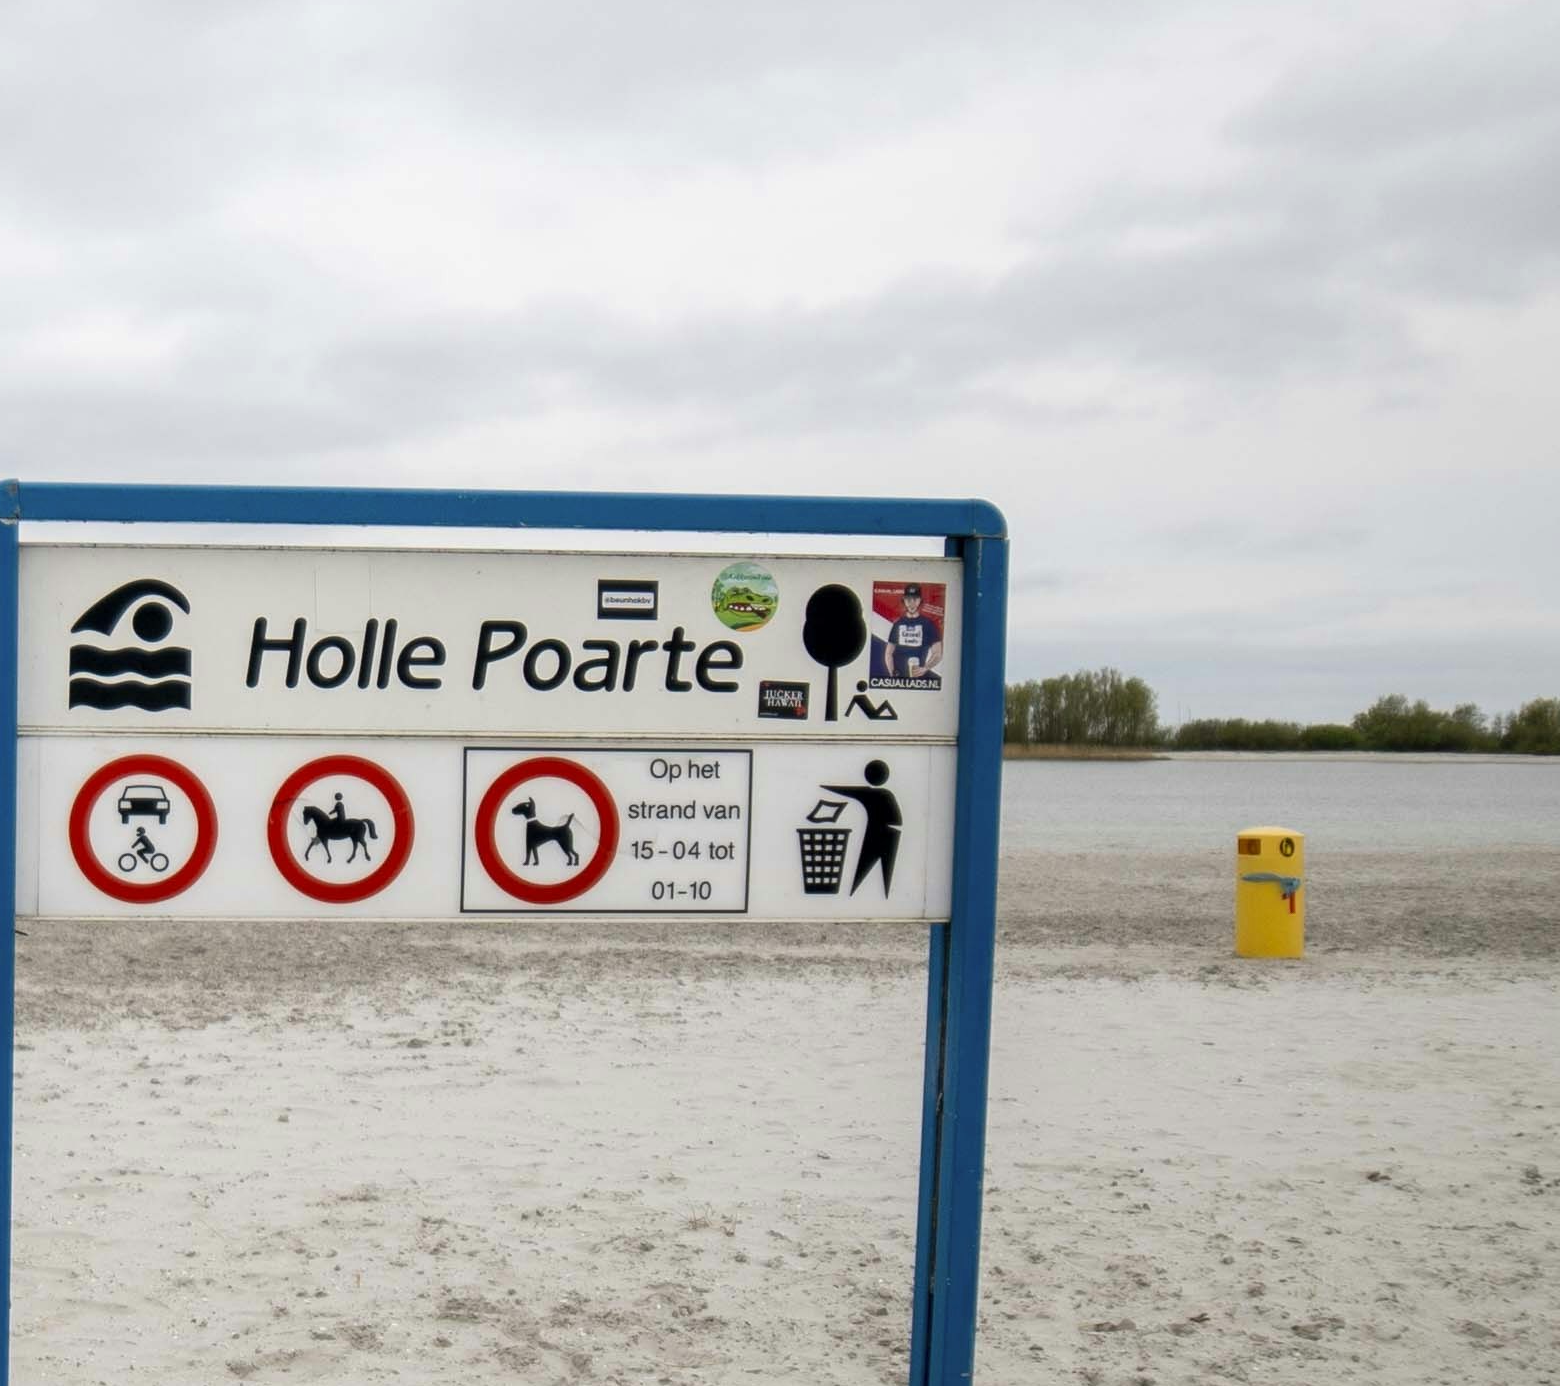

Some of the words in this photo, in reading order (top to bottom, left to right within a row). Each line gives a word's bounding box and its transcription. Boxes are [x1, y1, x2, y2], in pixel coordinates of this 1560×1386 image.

[245, 616, 447, 690] Holle
[472, 619, 744, 693] Poarte
[649, 758, 682, 783] Op
[688, 759, 720, 779] het
[628, 800, 696, 820] strand
[703, 804, 740, 820] van
[709, 841, 735, 860] tot
[651, 880, 712, 901] 01-10
